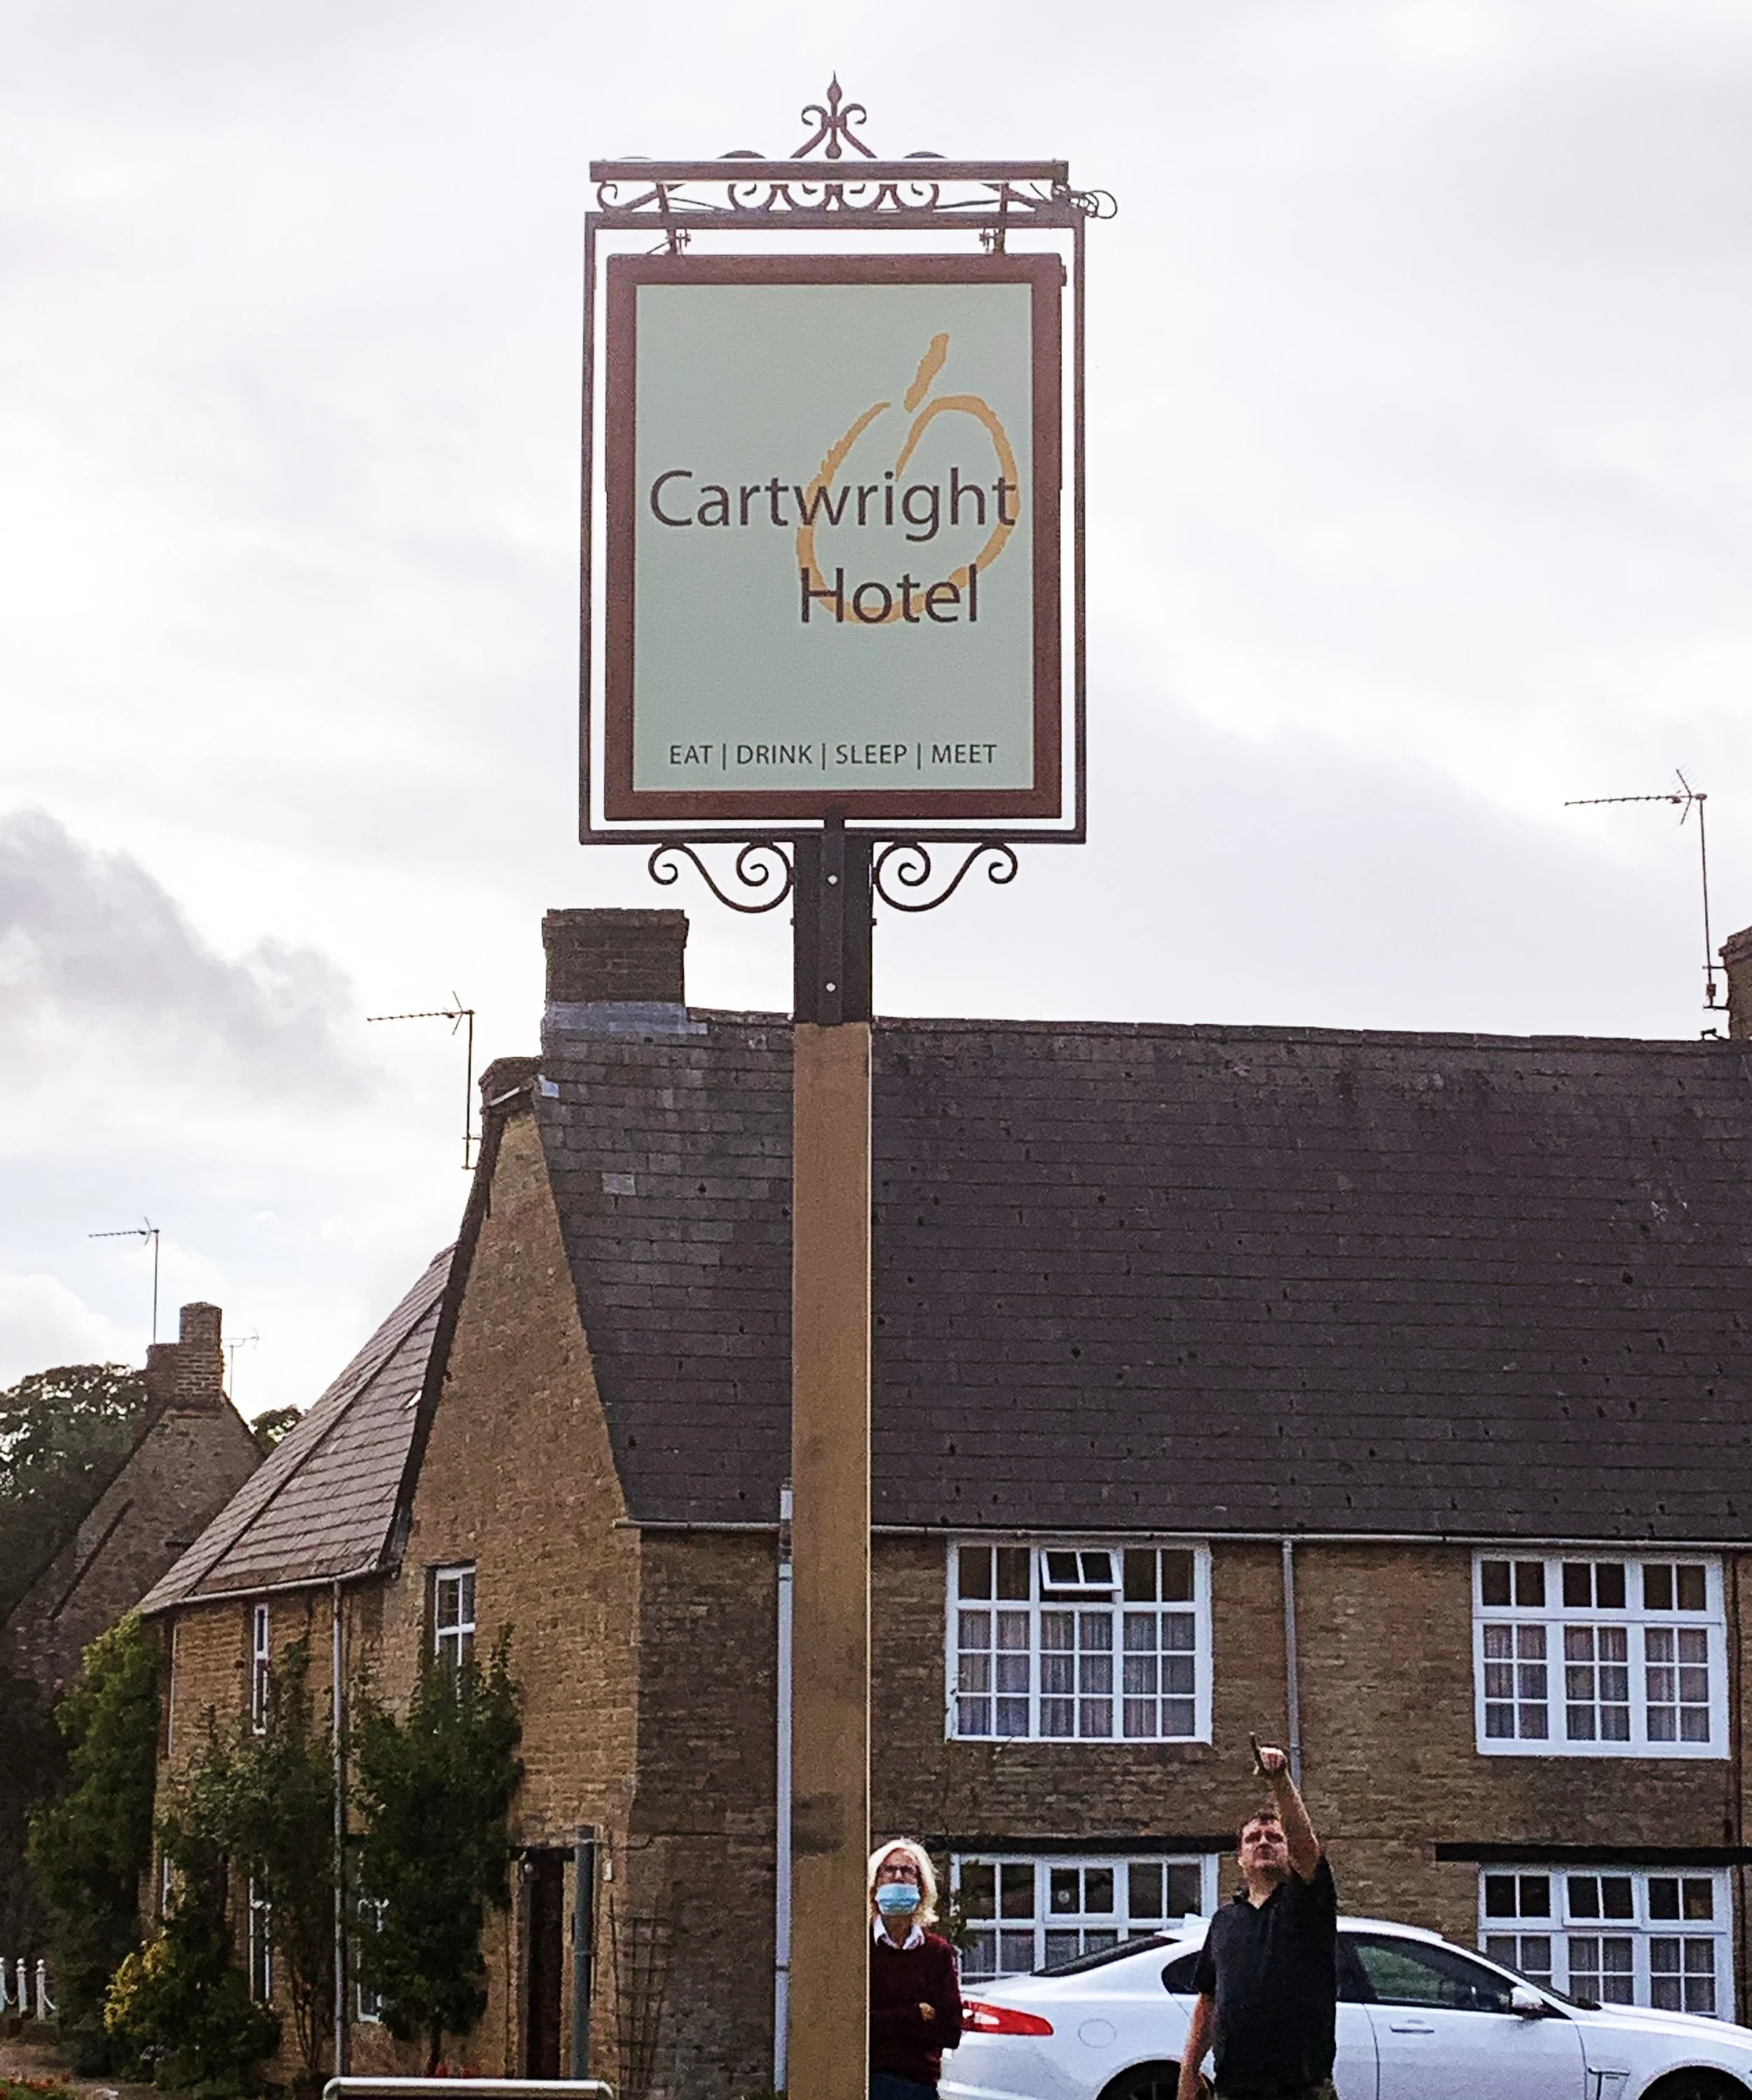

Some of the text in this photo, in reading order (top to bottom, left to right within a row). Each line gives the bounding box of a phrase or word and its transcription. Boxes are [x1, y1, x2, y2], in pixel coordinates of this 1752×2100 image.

[650, 466, 1017, 543] Cartwright
[800, 562, 978, 625] Hotel
[669, 744, 714, 766] EAT
[736, 744, 814, 765] DRINK
[835, 743, 908, 765] SLEEP
[931, 743, 999, 765] MEET
